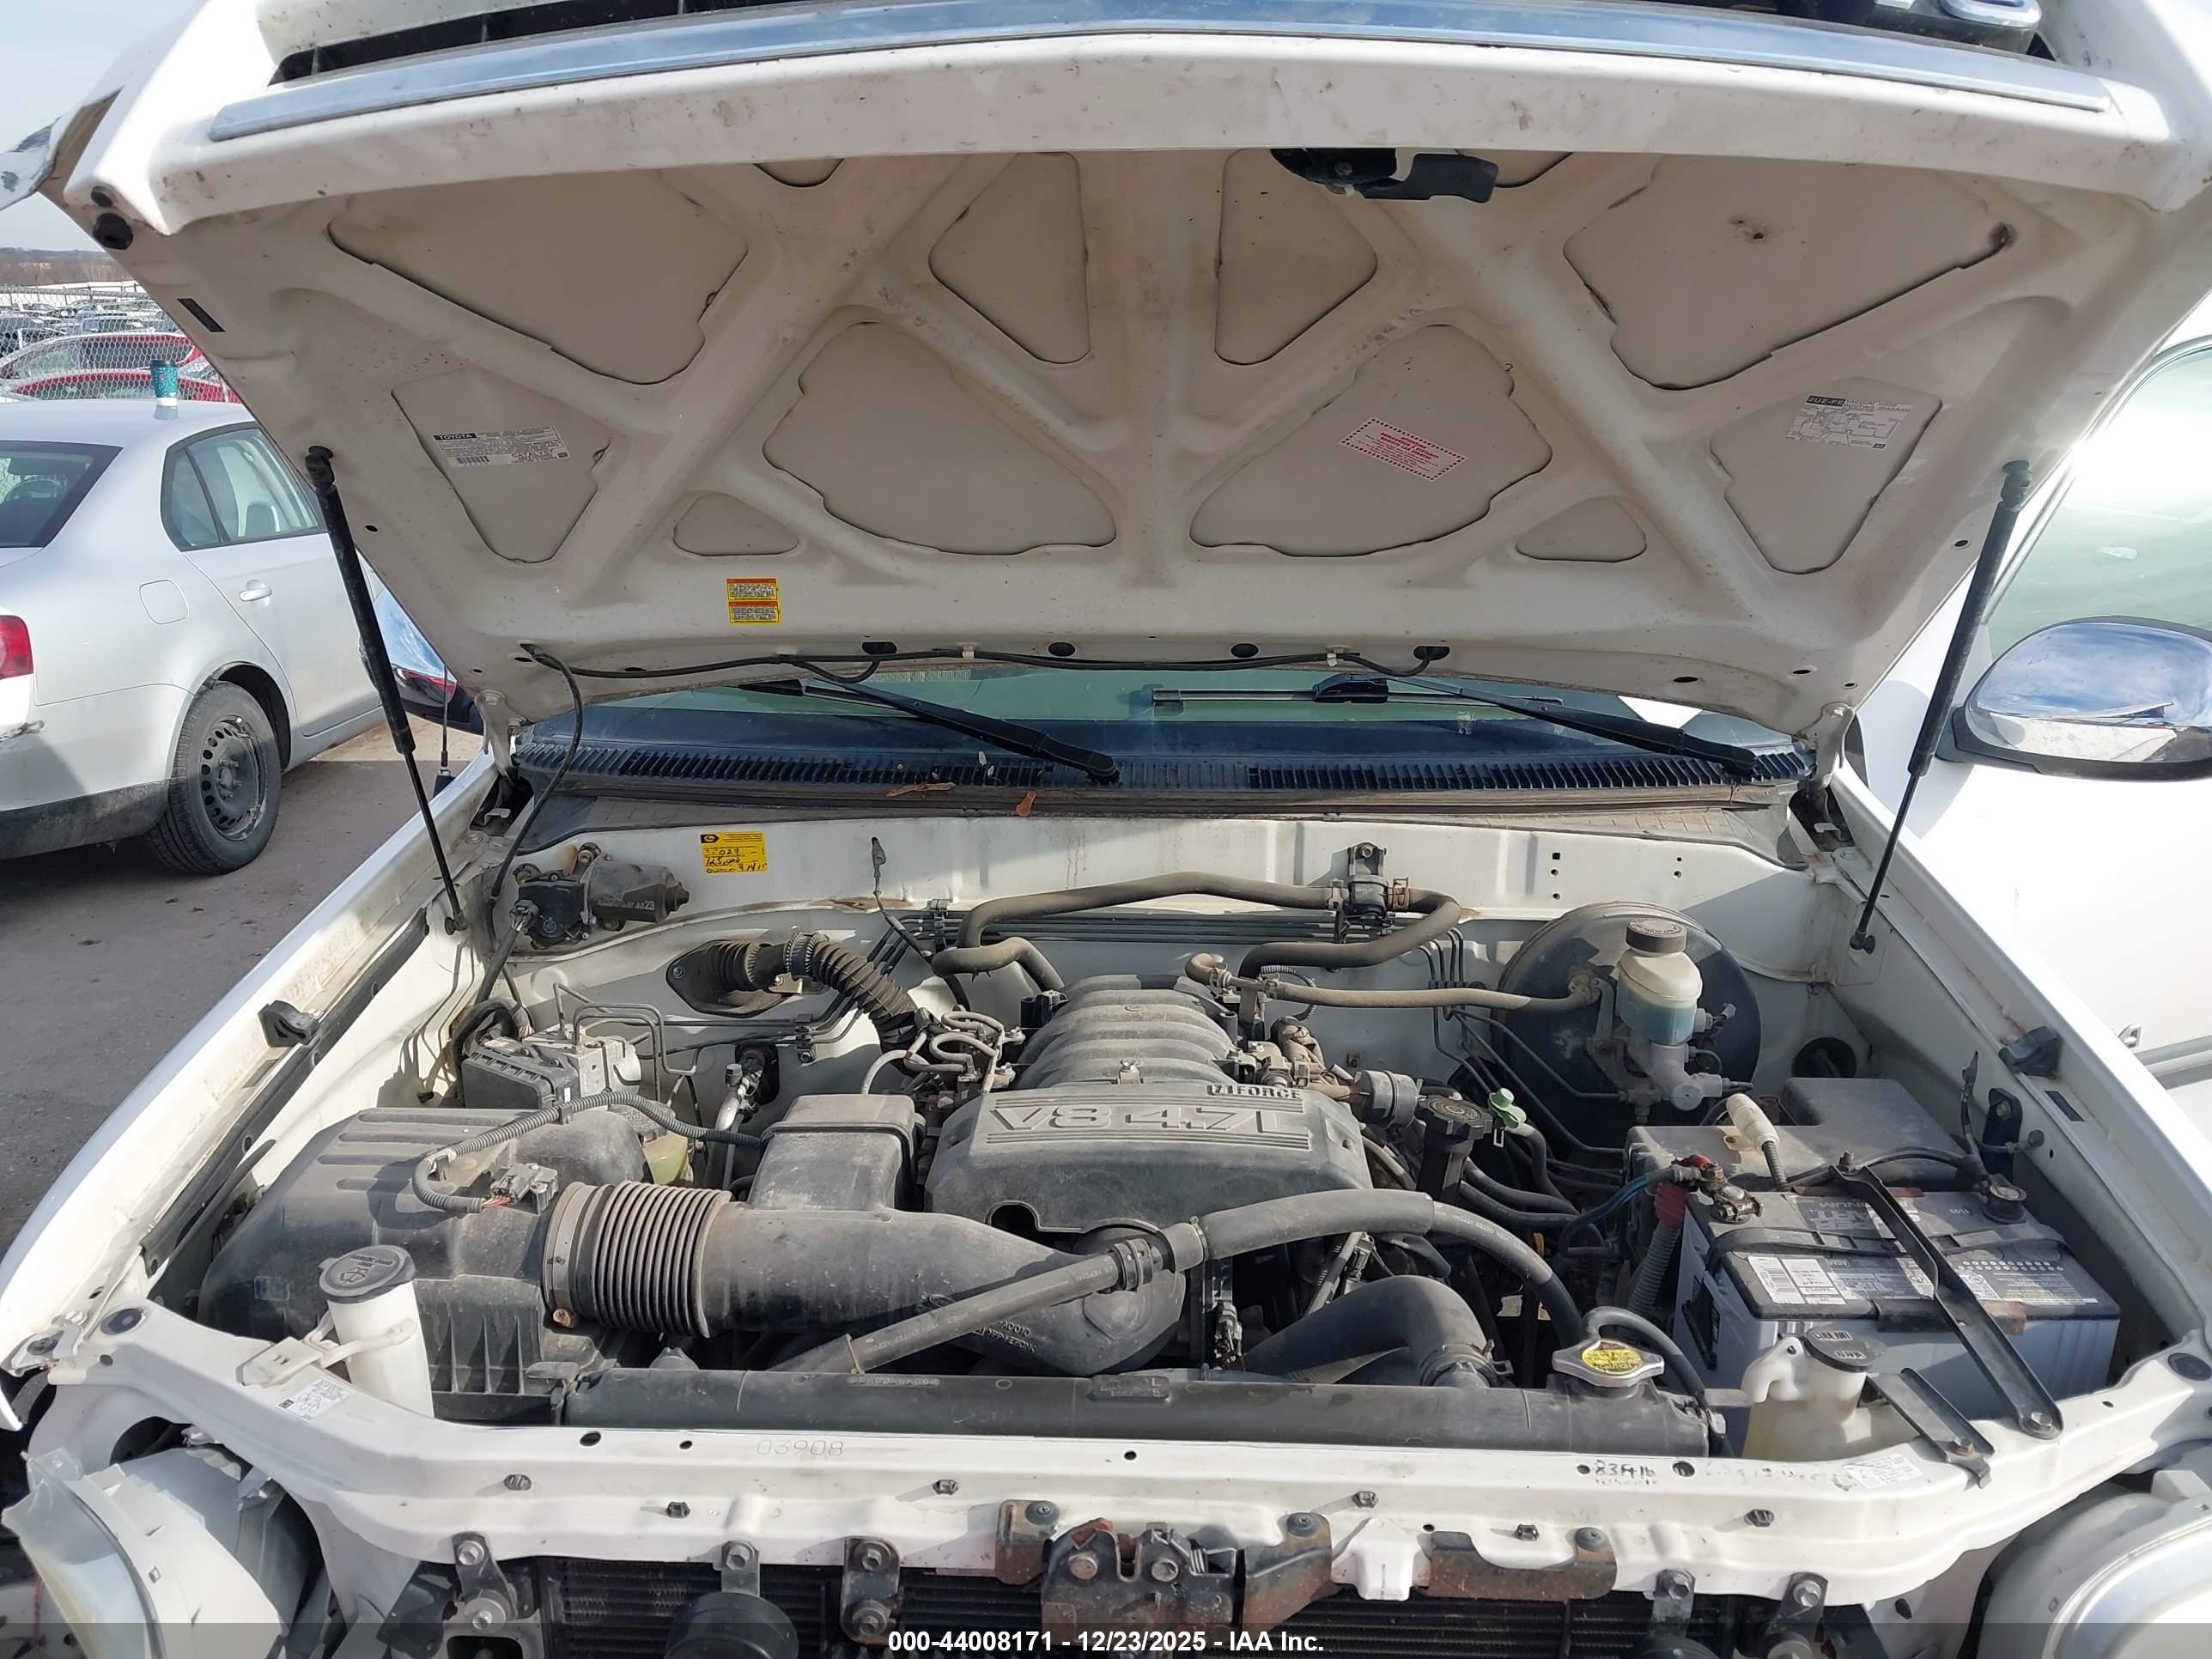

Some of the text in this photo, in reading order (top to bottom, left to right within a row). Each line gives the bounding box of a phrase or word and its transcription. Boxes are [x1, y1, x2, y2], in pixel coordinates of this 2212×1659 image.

[988, 1105, 1310, 1136] V8 4.7L
[756, 1438, 844, 1456] 03908
